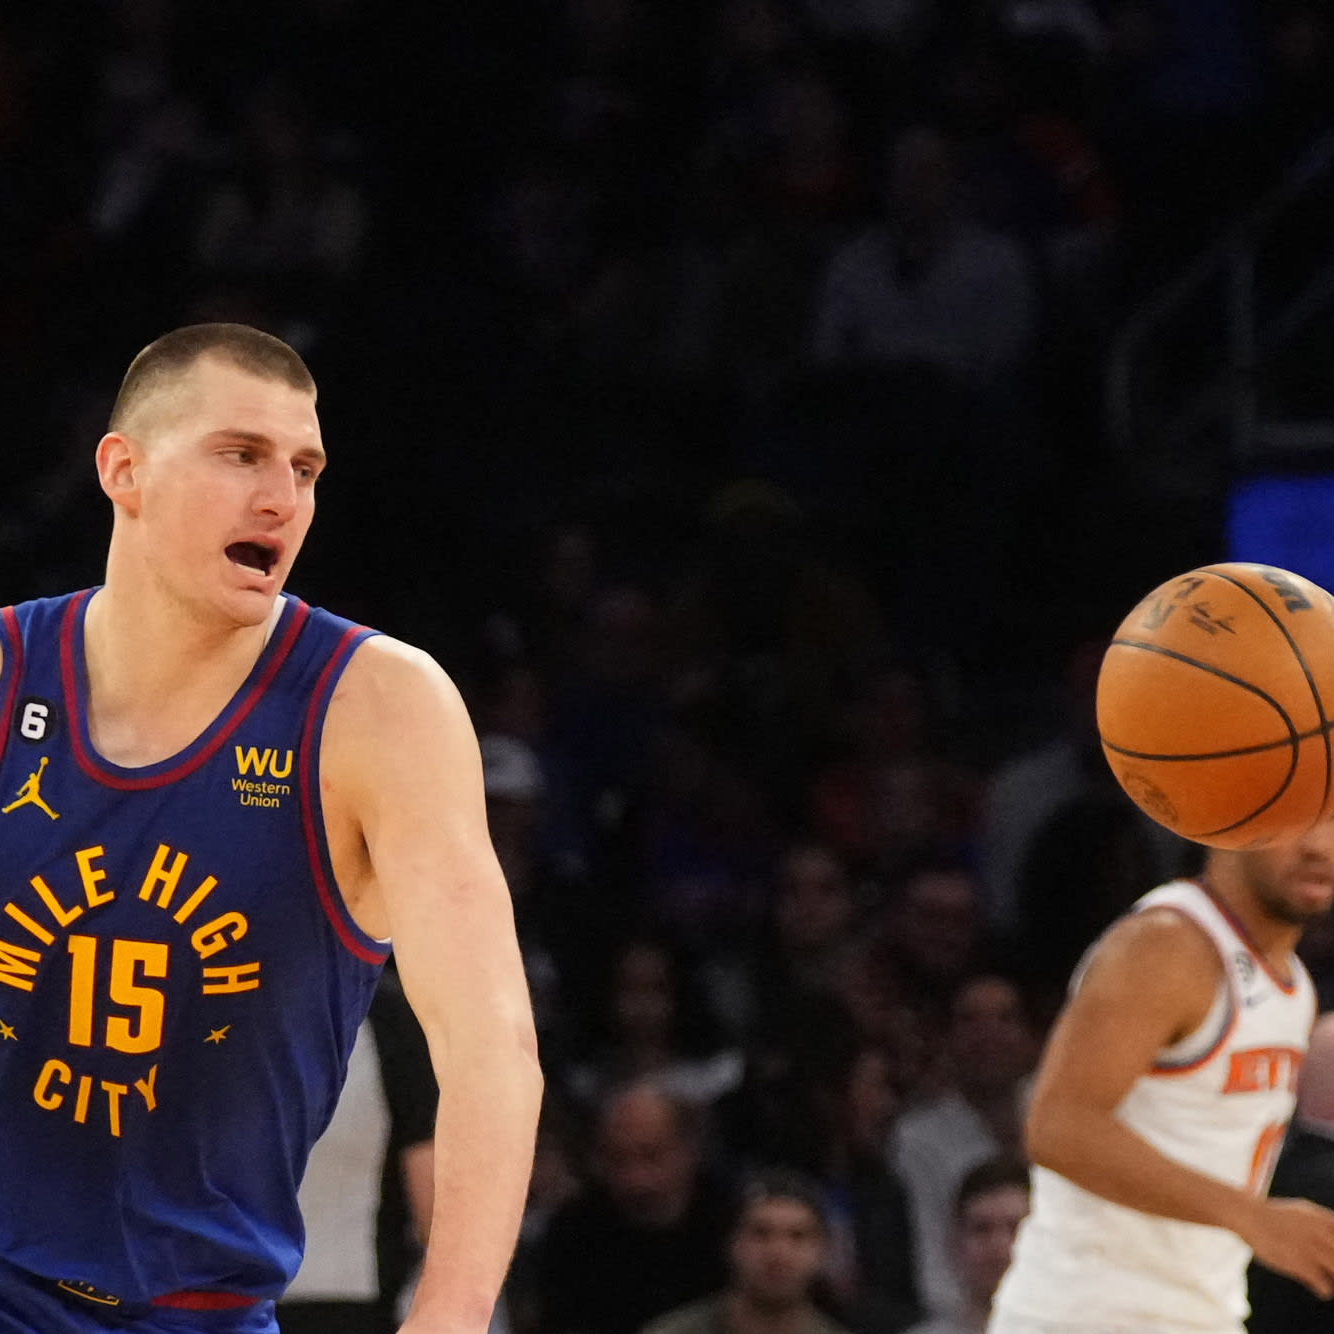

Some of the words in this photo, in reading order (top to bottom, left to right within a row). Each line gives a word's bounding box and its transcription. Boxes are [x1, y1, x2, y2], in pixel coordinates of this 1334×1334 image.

[20, 703, 49, 740] 6
[235, 746, 292, 778] WU
[231, 778, 291, 796] Western
[239, 793, 281, 810] Union
[138, 843, 261, 996] HIGH
[68, 934, 169, 1055] 15
[33, 1059, 158, 1138] CITY
